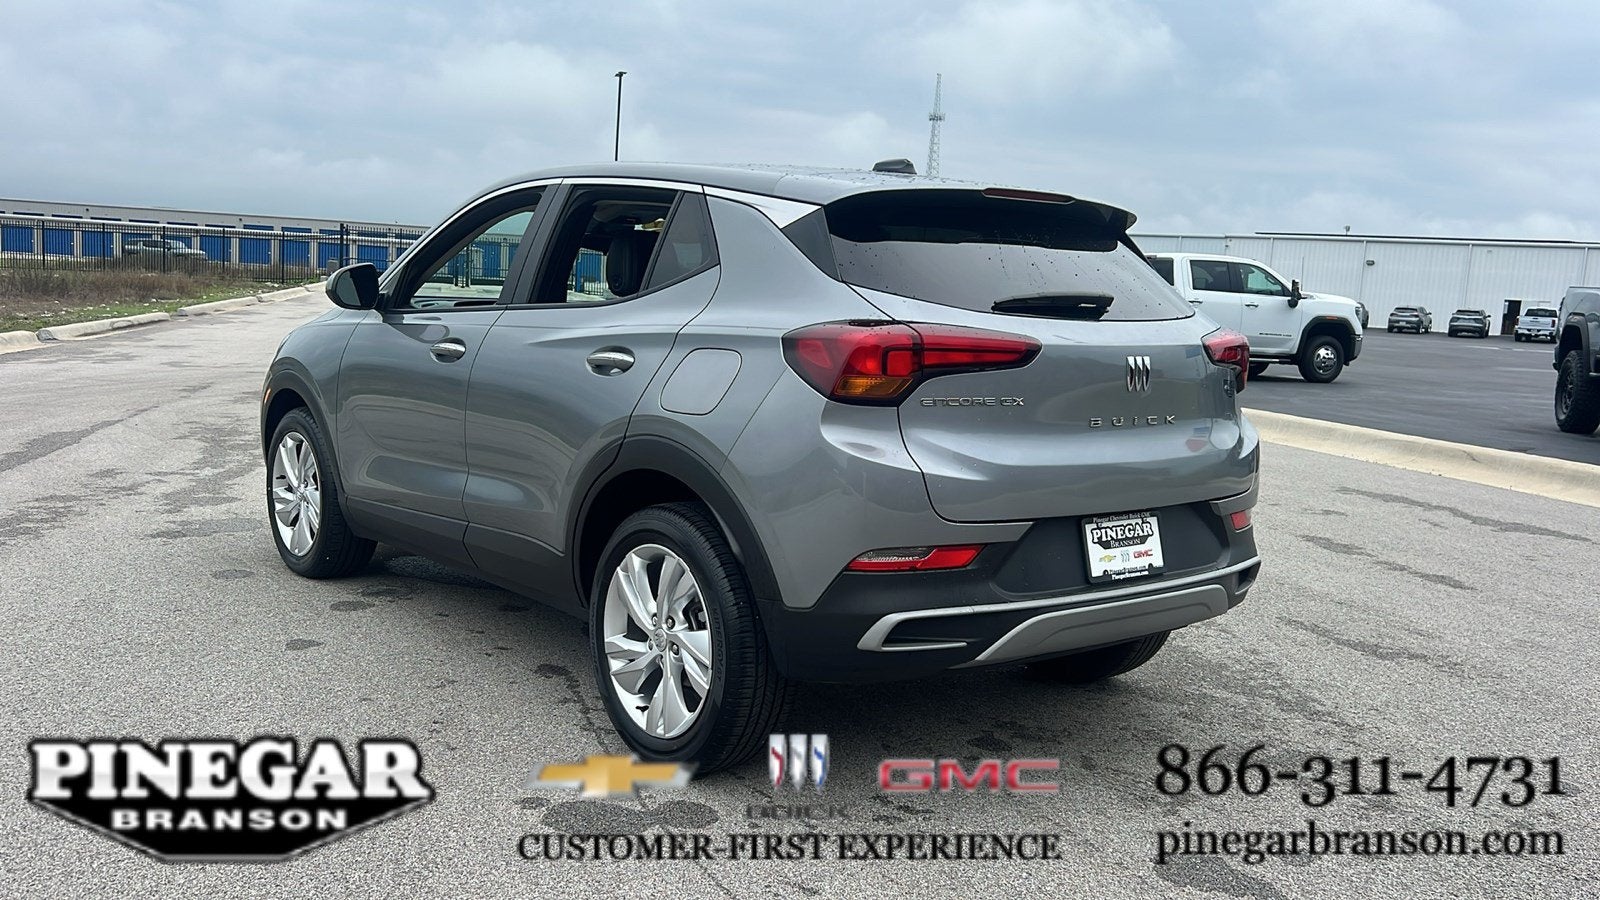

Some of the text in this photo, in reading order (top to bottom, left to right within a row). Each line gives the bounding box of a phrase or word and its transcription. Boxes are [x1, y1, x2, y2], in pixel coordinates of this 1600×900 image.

[920, 396, 1025, 407] ENCORE GX
[1088, 415, 1177, 428] BUICK
[1092, 522, 1153, 543] PINEGAR
[1133, 549, 1153, 559] GMC
